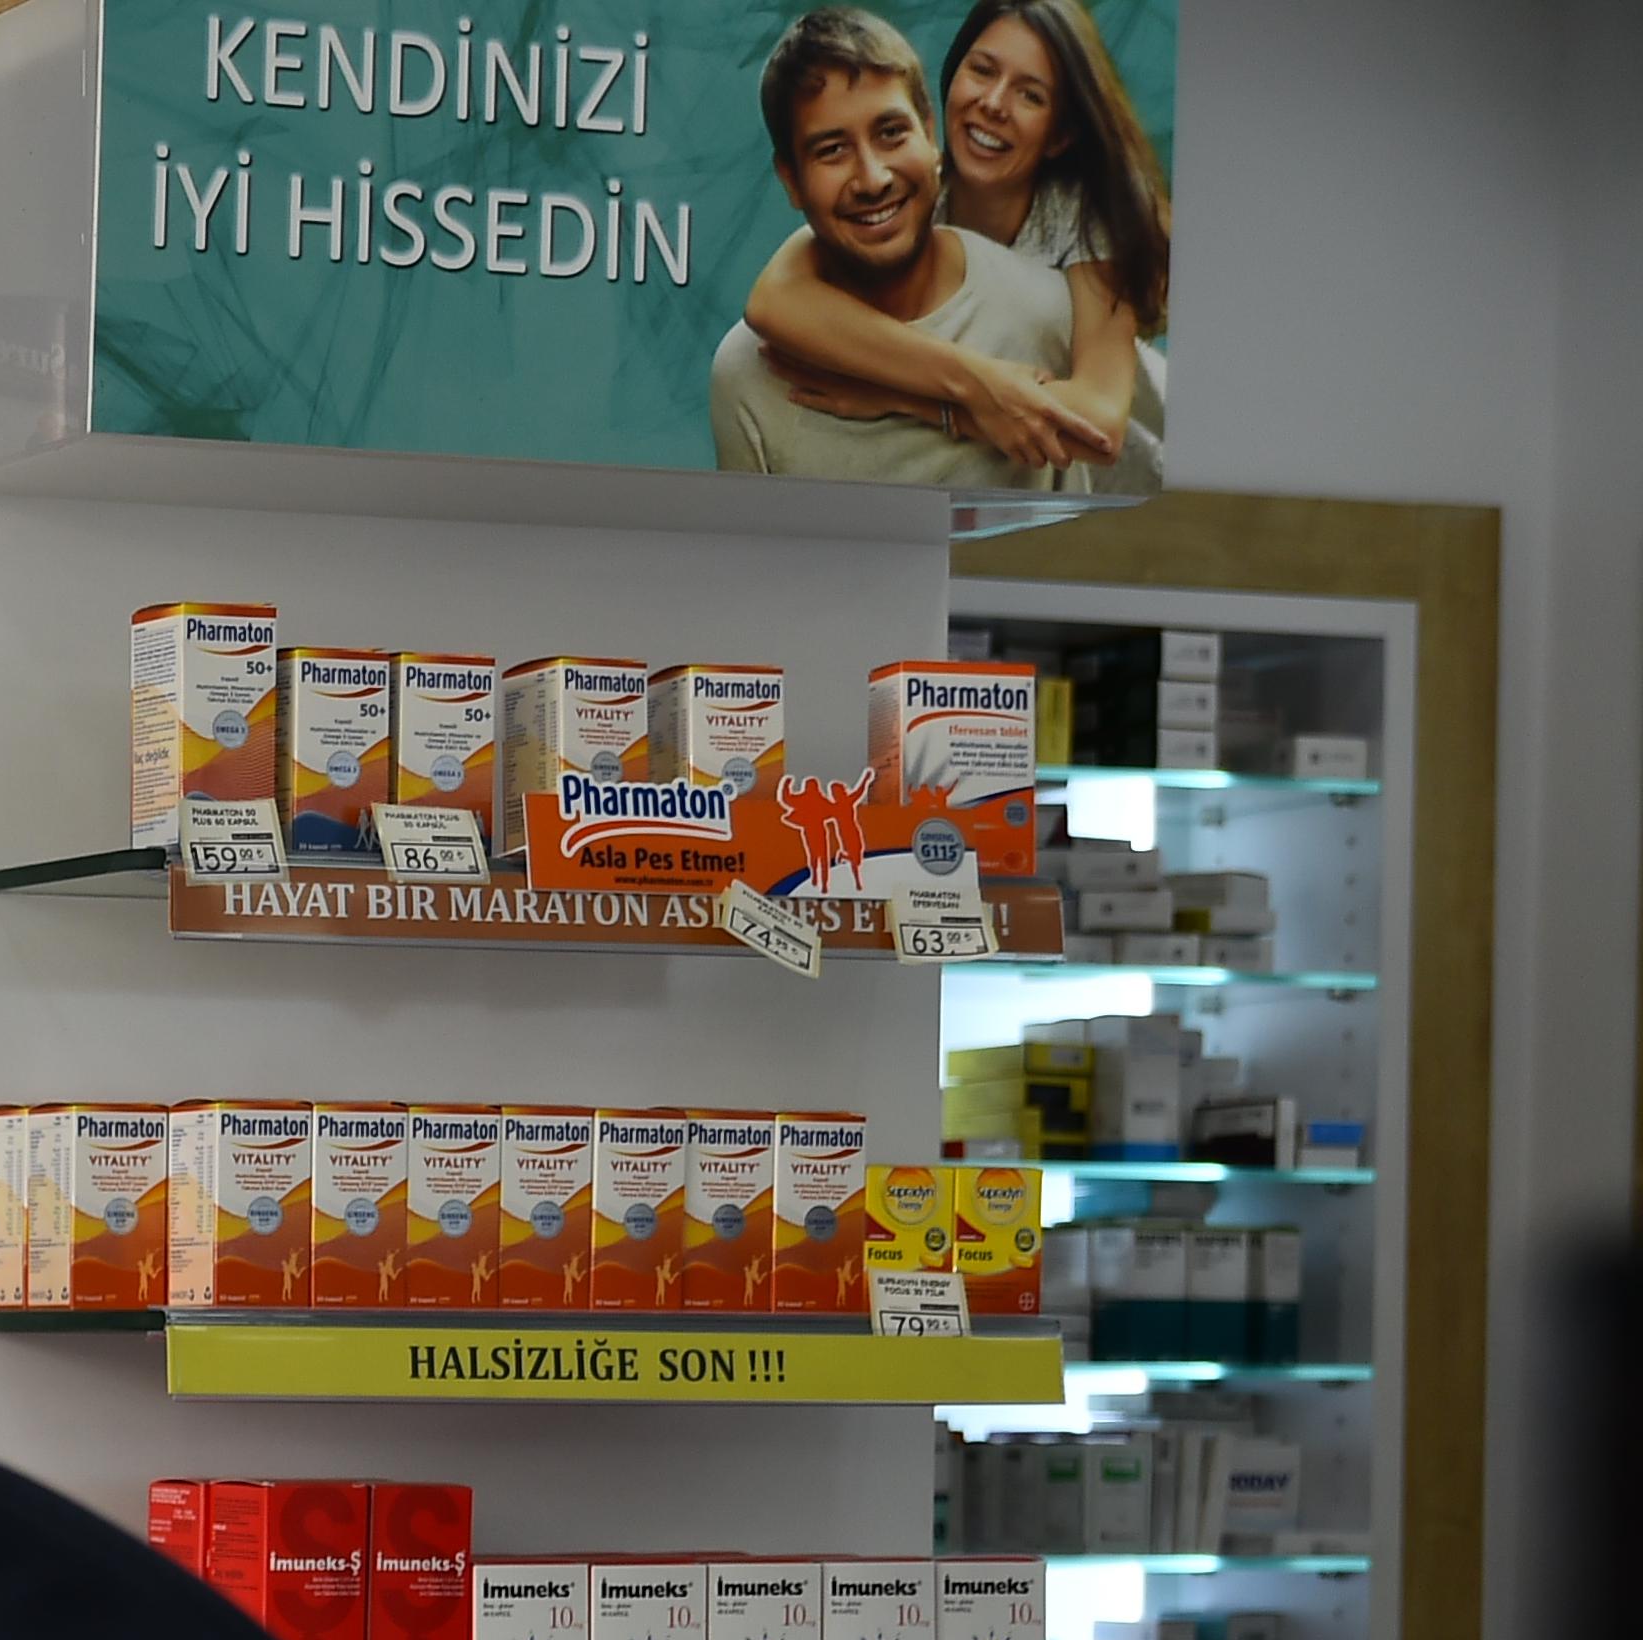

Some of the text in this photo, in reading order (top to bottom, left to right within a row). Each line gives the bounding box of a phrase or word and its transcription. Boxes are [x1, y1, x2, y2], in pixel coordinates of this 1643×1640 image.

[204, 13, 650, 137] KENDİNİZİ
[152, 142, 693, 288] İYİ HİSSEDİN
[186, 617, 273, 643] Pharmaton
[246, 661, 273, 675] 50+
[301, 661, 387, 687] Pharmaton
[405, 666, 492, 691] Pharmaton
[565, 669, 644, 693] Pharmaton
[694, 677, 780, 699] Pharmaton
[907, 678, 1028, 710] Pharmaton
[359, 704, 386, 718] 50+
[464, 709, 491, 722] 50+
[576, 709, 629, 721] VITALITY
[707, 716, 764, 727] VITALITY
[563, 775, 725, 820] Pharmaton
[580, 845, 745, 872] Asla Pes Etme!
[921, 842, 959, 861] G115
[223, 881, 355, 919] HAYAT
[366, 879, 439, 922] BİR
[448, 885, 649, 926] MARATON
[77, 1116, 165, 1139] Pharmaton
[221, 1113, 308, 1138] Pharmaton
[318, 1116, 405, 1139] Pharmaton
[413, 1118, 498, 1140] Pharmaton
[505, 1118, 591, 1142] Pharmaton
[599, 1121, 684, 1145] Pharmaton
[688, 1122, 771, 1146] Pharmaton
[780, 1124, 863, 1148] Pharmaton
[90, 1155, 149, 1168] VITALITY
[233, 1153, 292, 1166] VITALITY
[329, 1155, 390, 1168] VITALITY
[424, 1157, 483, 1170] VITALITY
[517, 1158, 576, 1171] VITALITY
[611, 1161, 670, 1174] VITALITY
[699, 1163, 758, 1175] VITALITY
[791, 1163, 850, 1176] VITALITY
[868, 1248, 903, 1260] Focus
[958, 1249, 993, 1261] Focus
[409, 1338, 638, 1382] HALSİZLİĞE
[659, 1348, 736, 1382] SON
